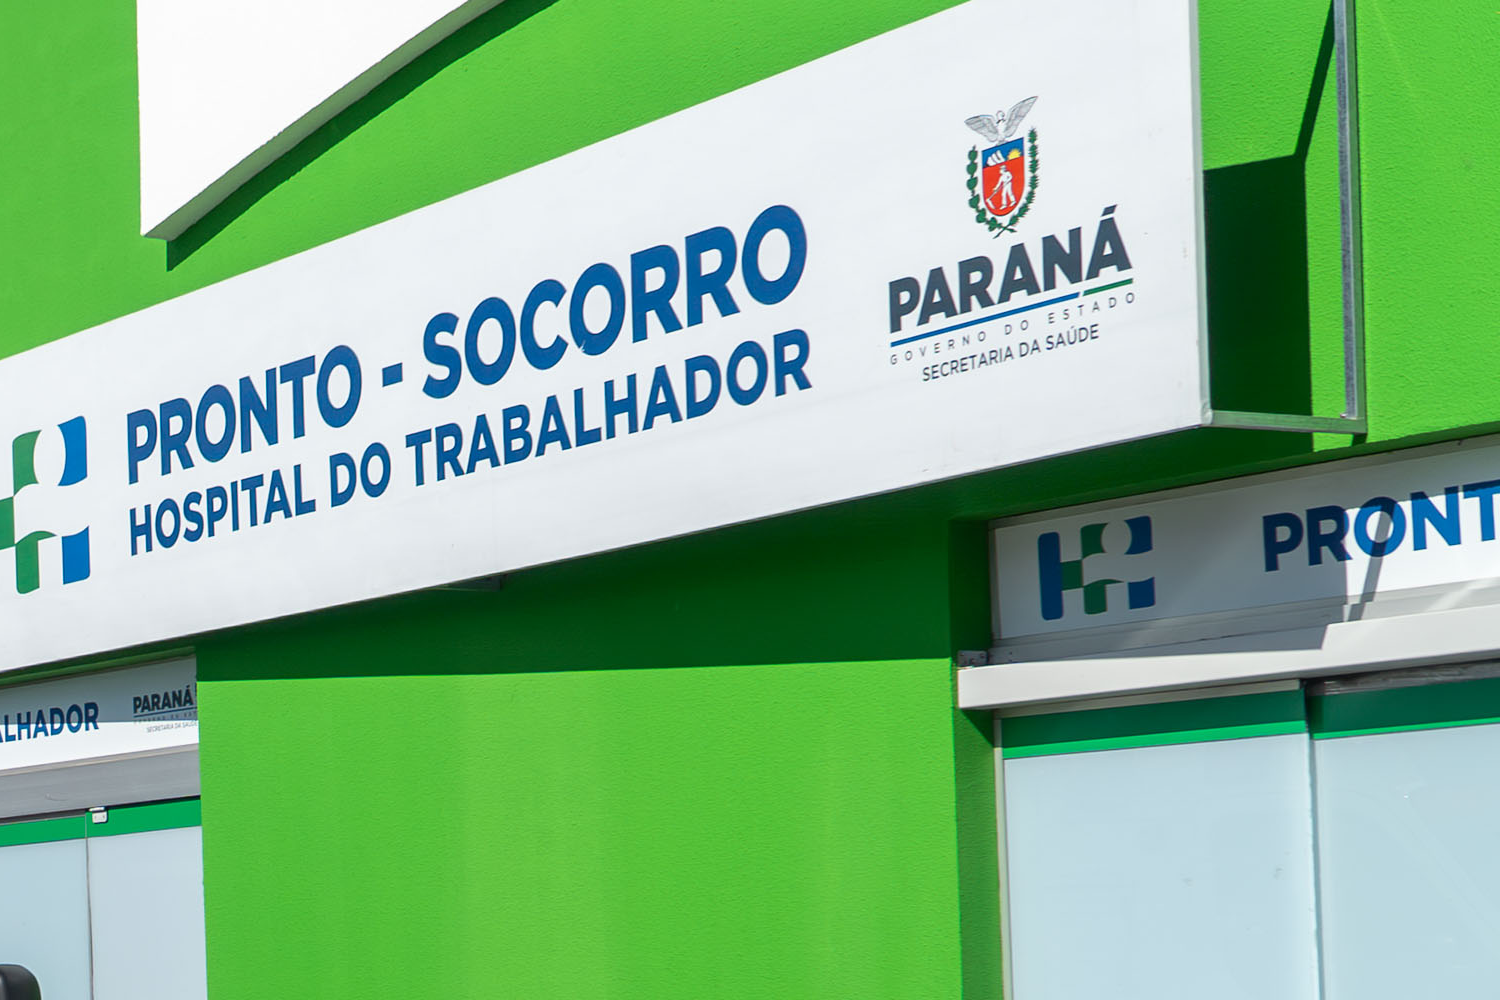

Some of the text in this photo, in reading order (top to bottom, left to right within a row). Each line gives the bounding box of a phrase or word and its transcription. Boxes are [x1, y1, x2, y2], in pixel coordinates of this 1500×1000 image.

[888, 204, 1133, 334] PARANÁ
[127, 205, 808, 485] PRONTO - SOCORRO
[890, 292, 1136, 366] GOVERNO DO ESTADO
[922, 322, 1100, 382] SECRETARIA DA SAÚDE
[129, 329, 812, 557] HOSPITAL DO TRABALHADOR
[132, 684, 194, 713] PARANÁ
